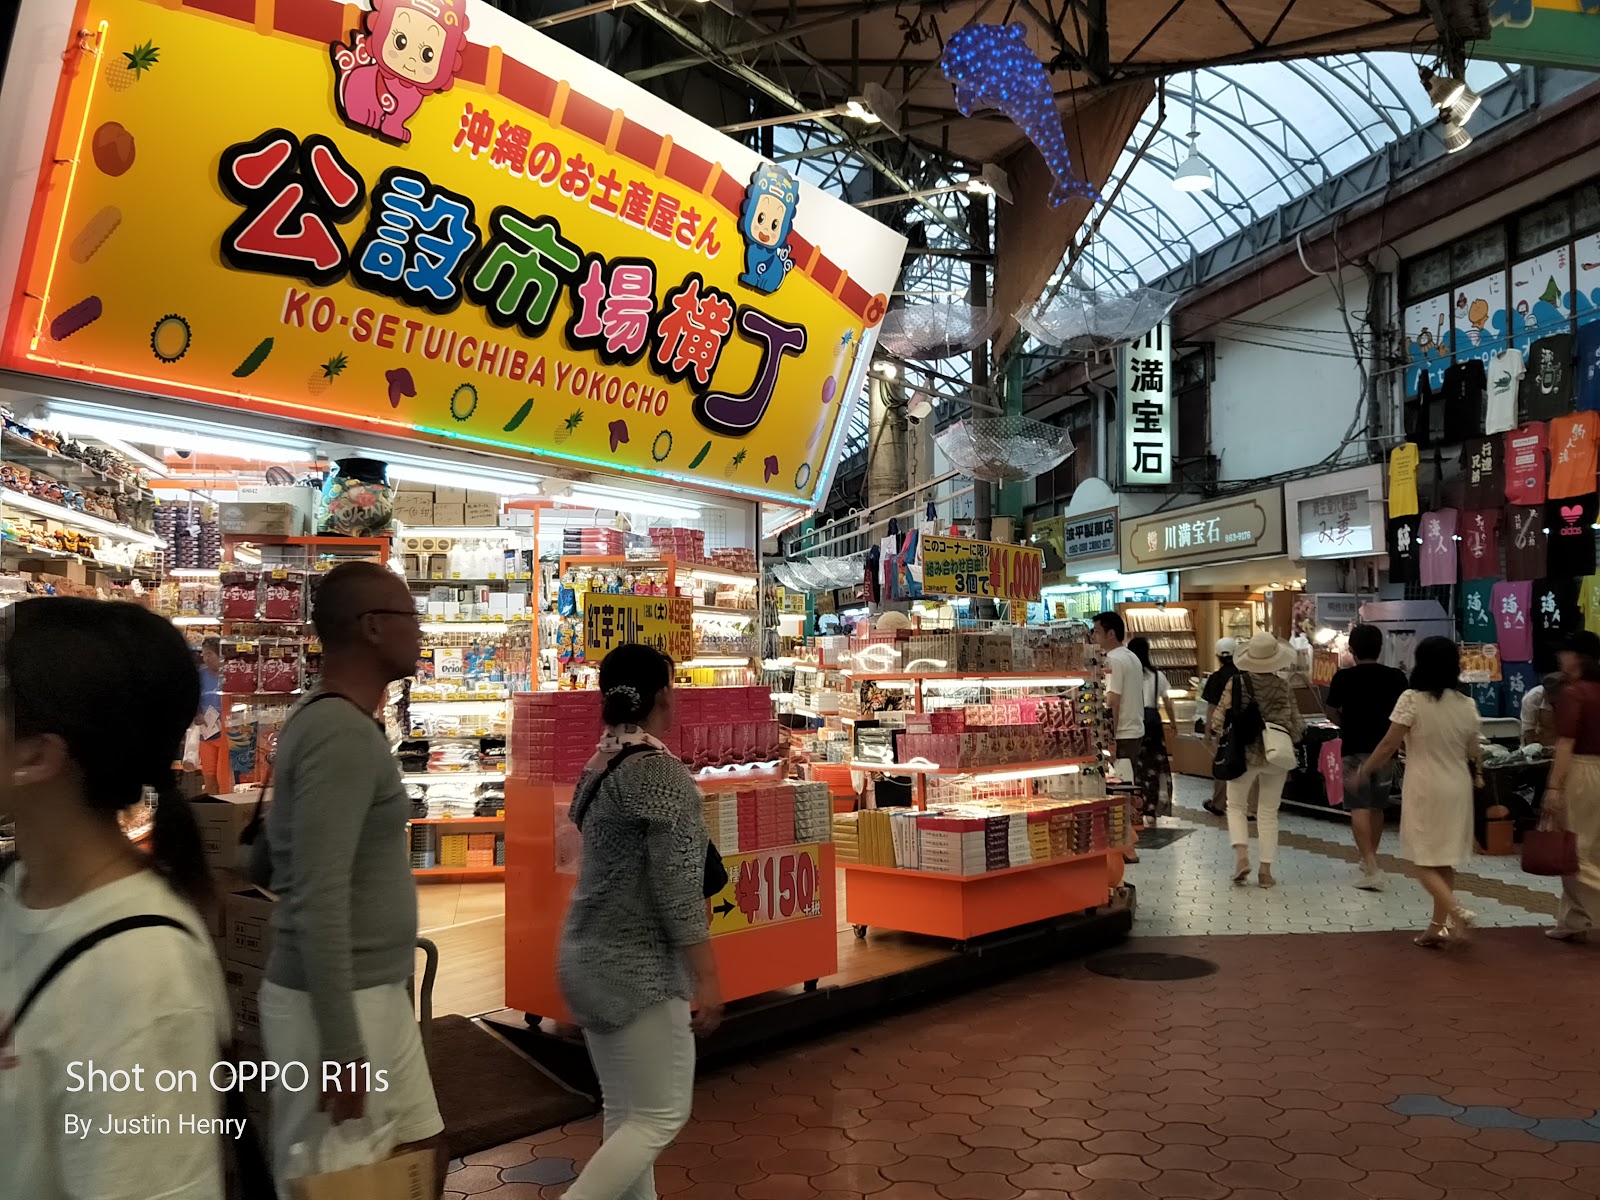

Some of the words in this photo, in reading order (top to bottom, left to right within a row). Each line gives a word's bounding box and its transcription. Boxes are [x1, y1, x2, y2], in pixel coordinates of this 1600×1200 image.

[452, 101, 722, 259] 沖縄のお土産屋さん
[222, 128, 807, 435] 公設市場横丁
[281, 287, 547, 388] KO-SETUICHIBA
[553, 360, 670, 418] YOKOCHO
[924, 539, 990, 558] このコーナーに限り
[1164, 516, 1220, 551] 川満宝石
[955, 573, 990, 595] 3個で
[739, 851, 815, 924] ¥150
